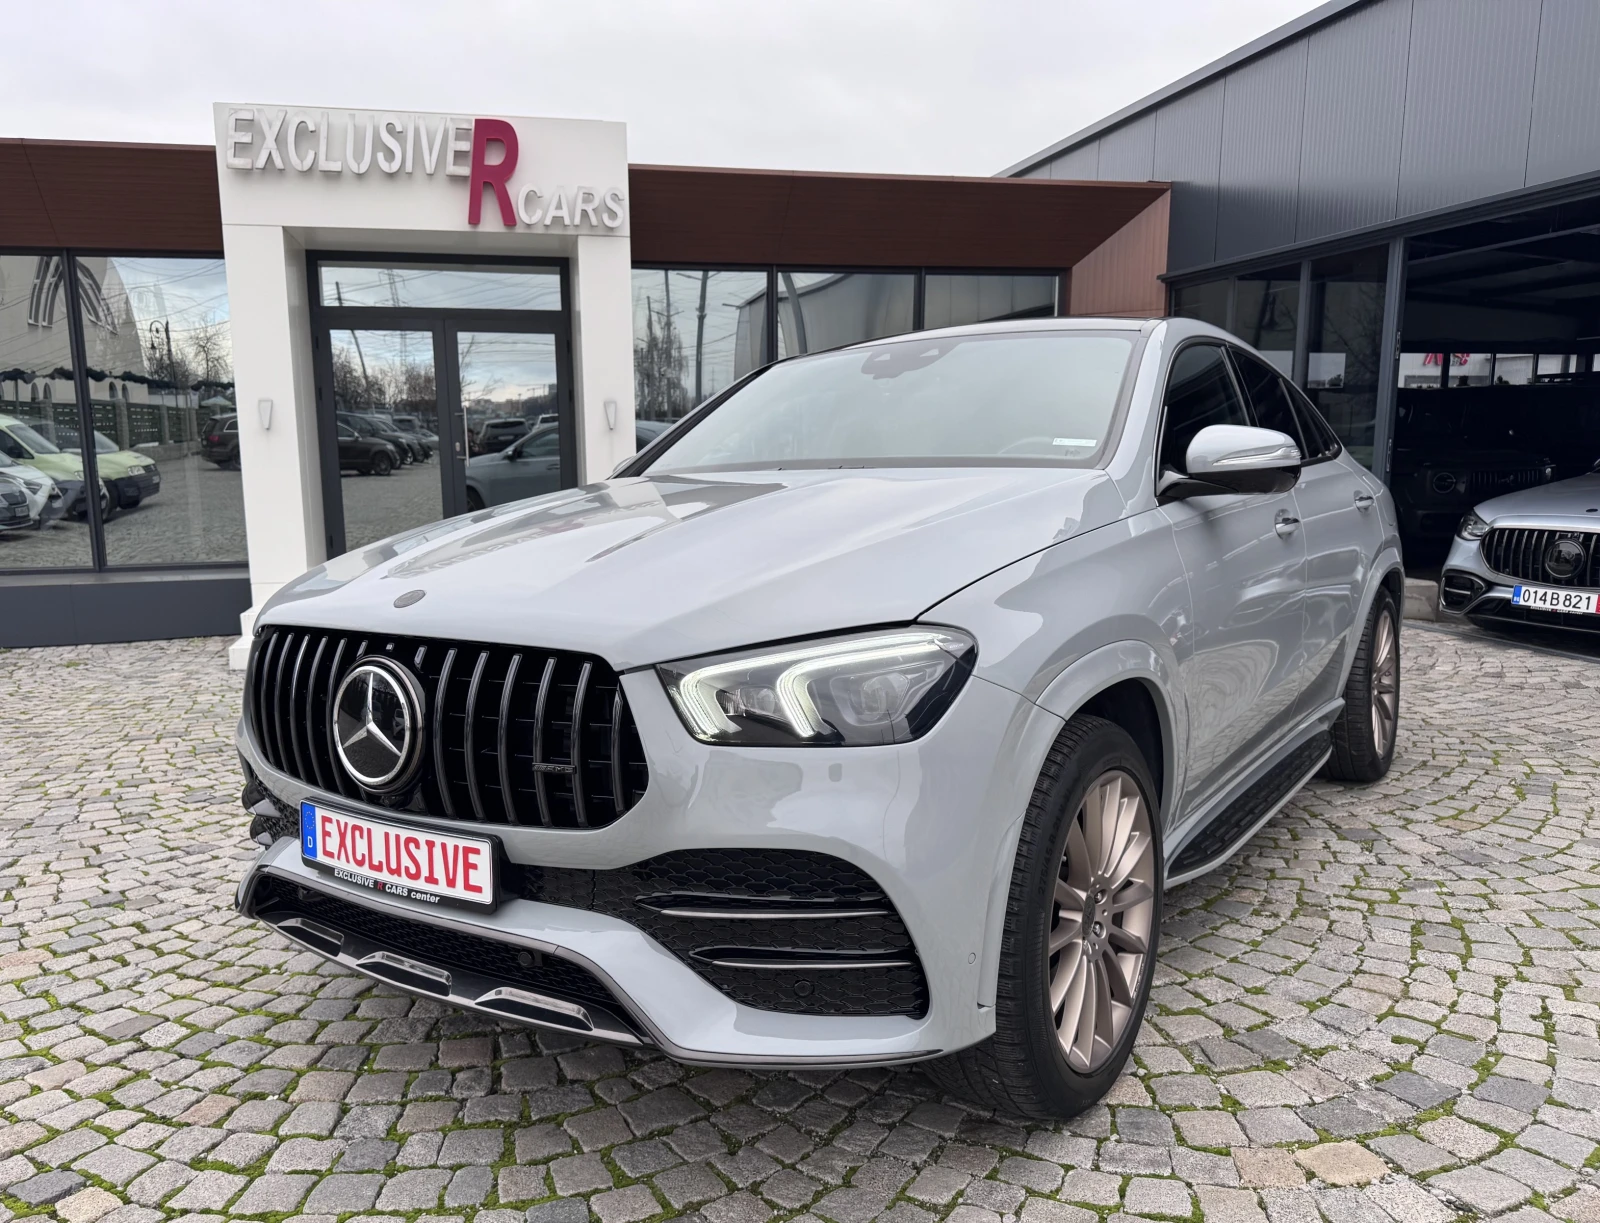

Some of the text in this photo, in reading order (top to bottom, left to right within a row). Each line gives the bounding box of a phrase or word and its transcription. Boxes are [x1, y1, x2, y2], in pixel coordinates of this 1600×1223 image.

[226, 108, 625, 229] EXCLUSIVE R CARS
[307, 835, 313, 848] D
[321, 815, 483, 893] EXCLUSIVE
[334, 868, 440, 903] EXCLUSIVE R CARS center
